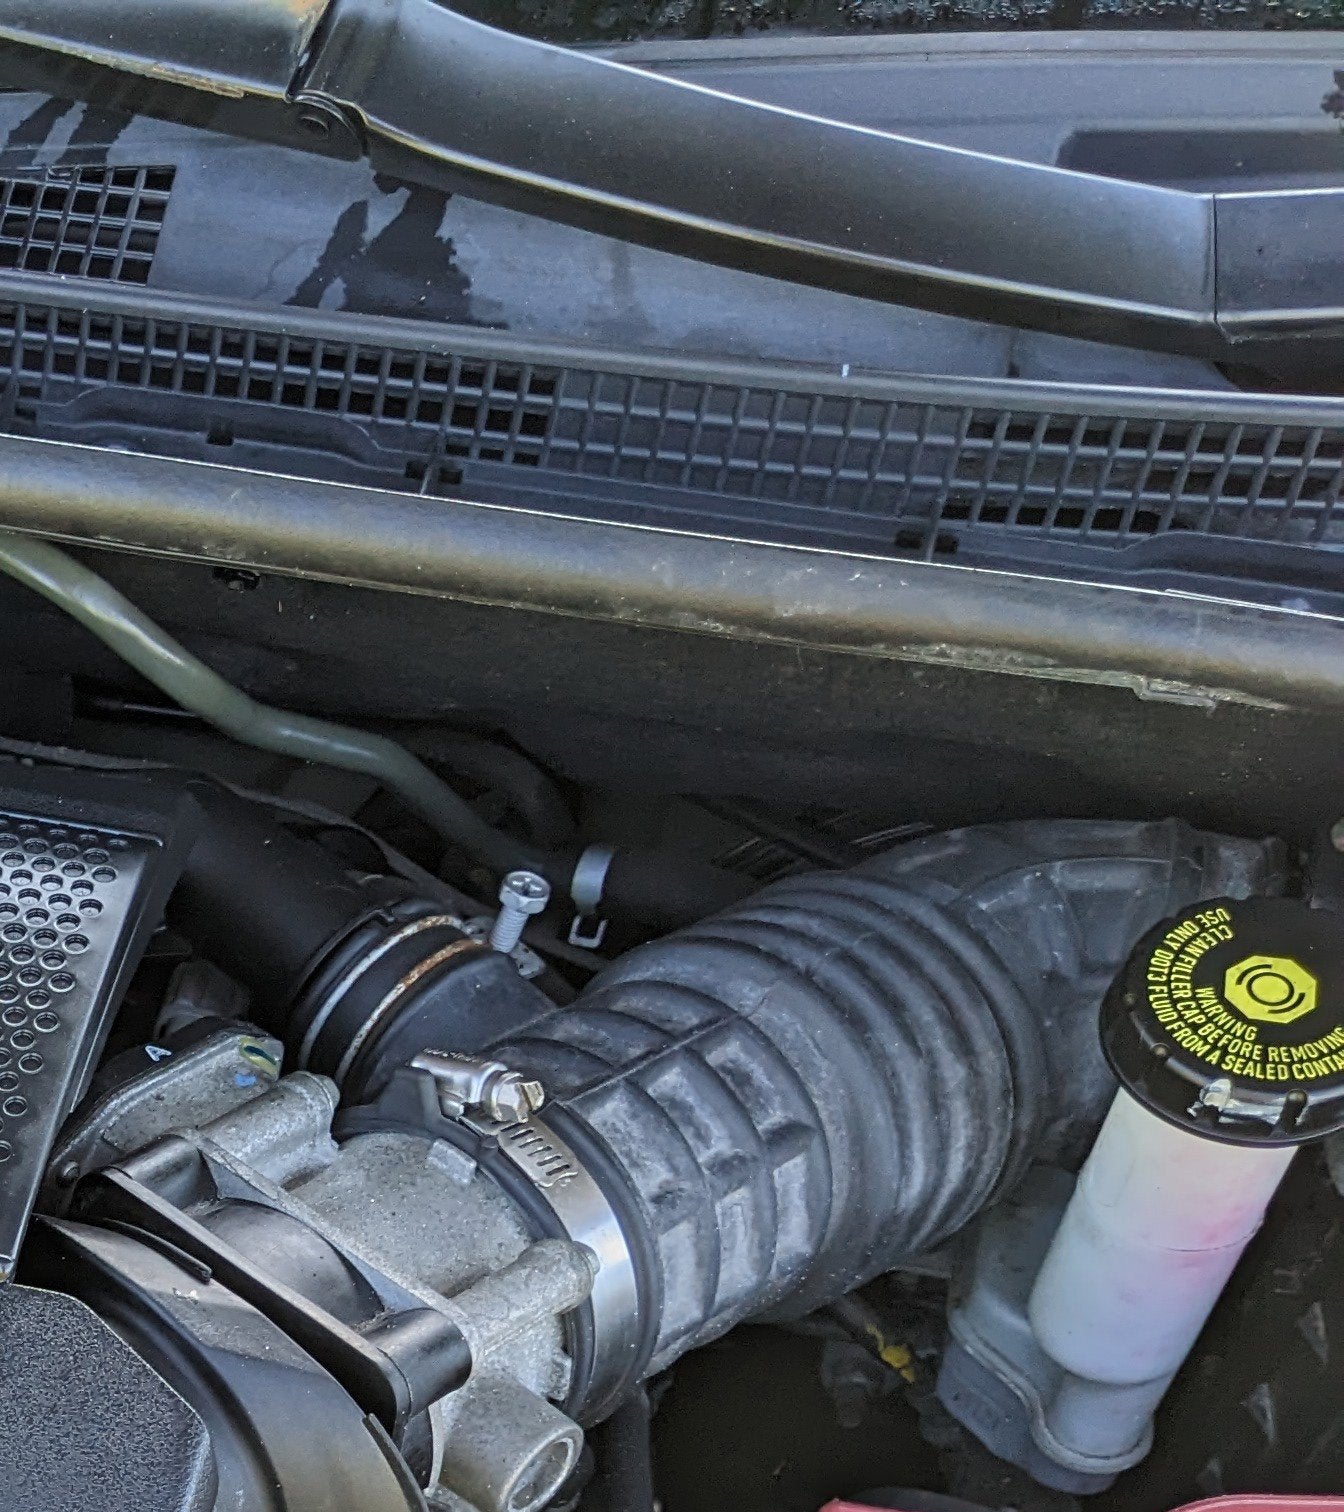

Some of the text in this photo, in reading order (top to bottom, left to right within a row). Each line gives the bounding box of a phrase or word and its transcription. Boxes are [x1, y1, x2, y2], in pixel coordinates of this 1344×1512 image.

[1147, 908, 1344, 1080] USE ONLY DOT3 FLUID FROM A SEALED CONTA
[1170, 925, 1344, 1062] CLEAN FILLER CAP BEFORE REMOVING
[1195, 987, 1257, 1041] WARNING
